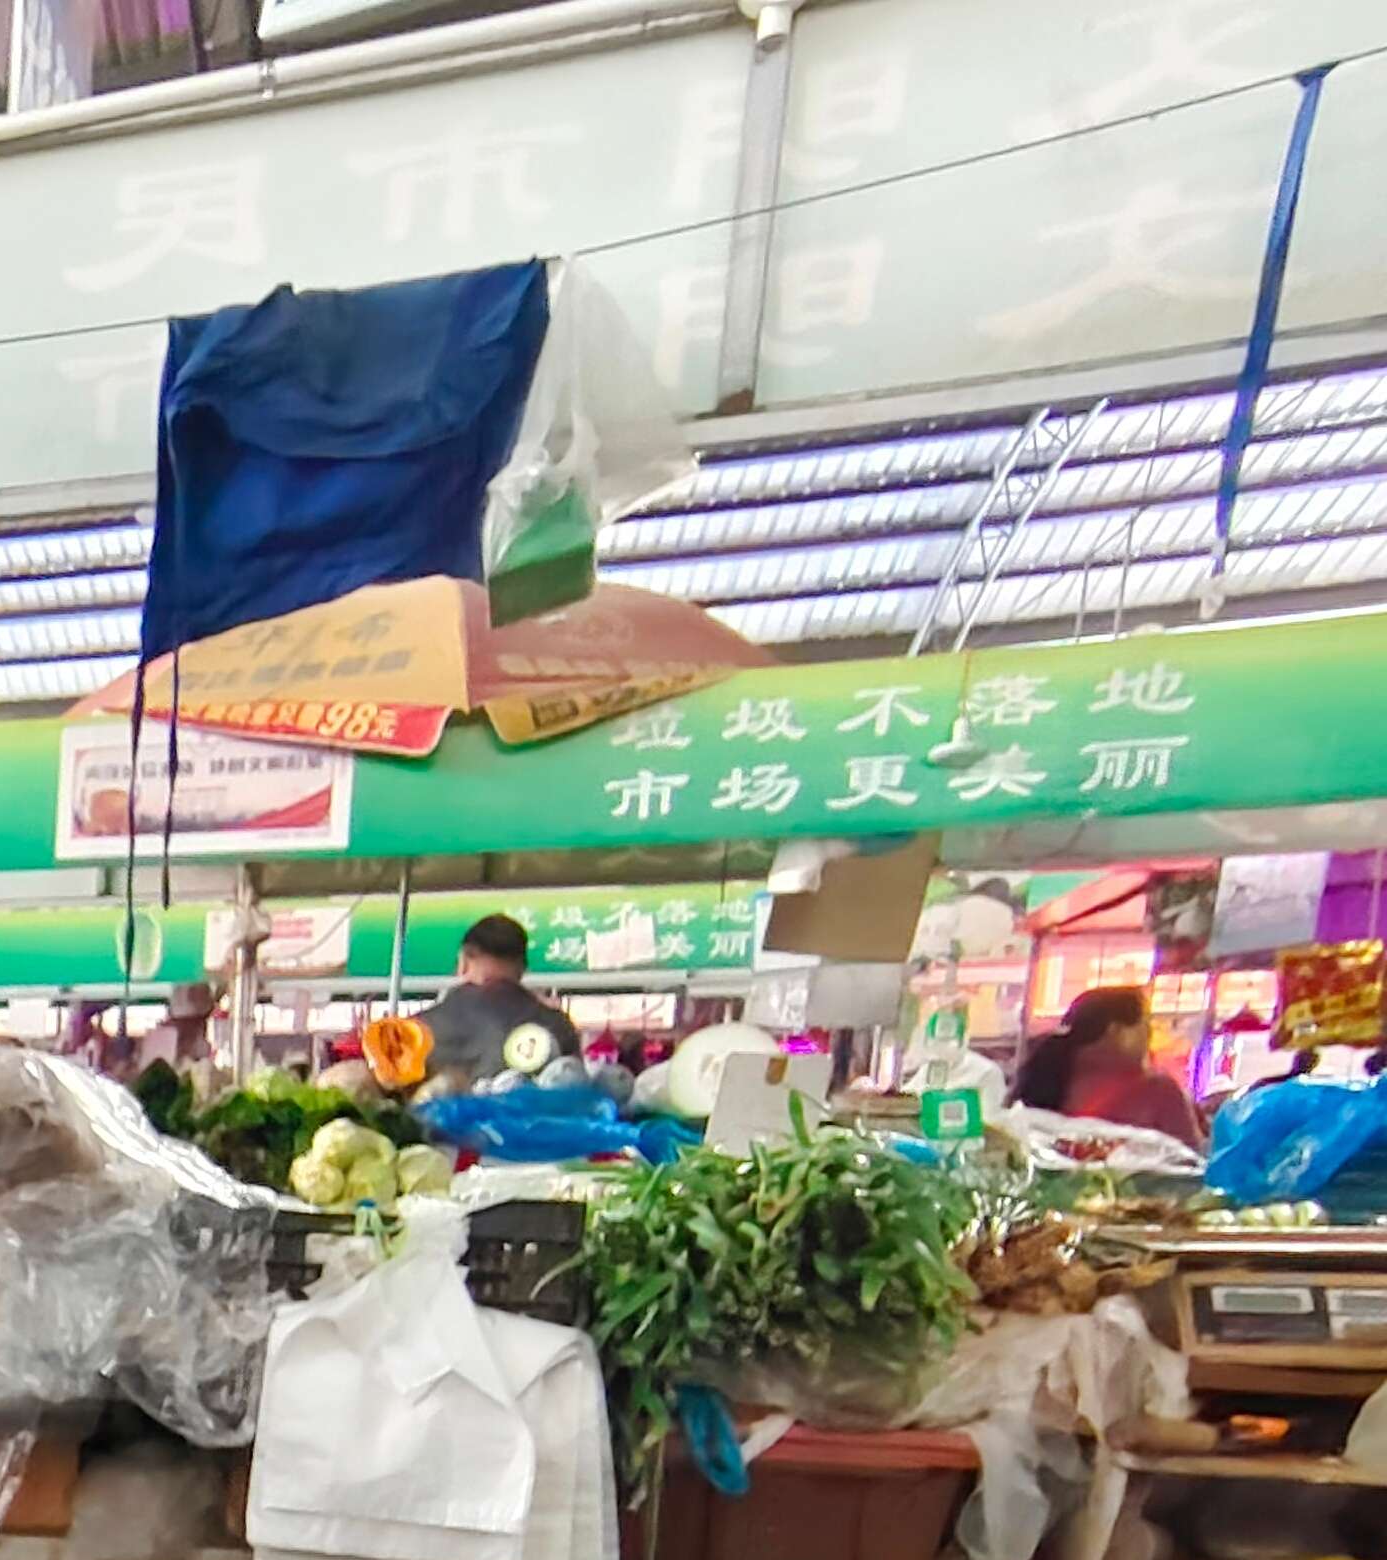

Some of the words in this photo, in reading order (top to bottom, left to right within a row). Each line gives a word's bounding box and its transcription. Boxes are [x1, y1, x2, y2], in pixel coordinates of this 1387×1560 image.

[610, 661, 1196, 751] 垃圾不落地
[604, 735, 1191, 820] 市场更美丽
